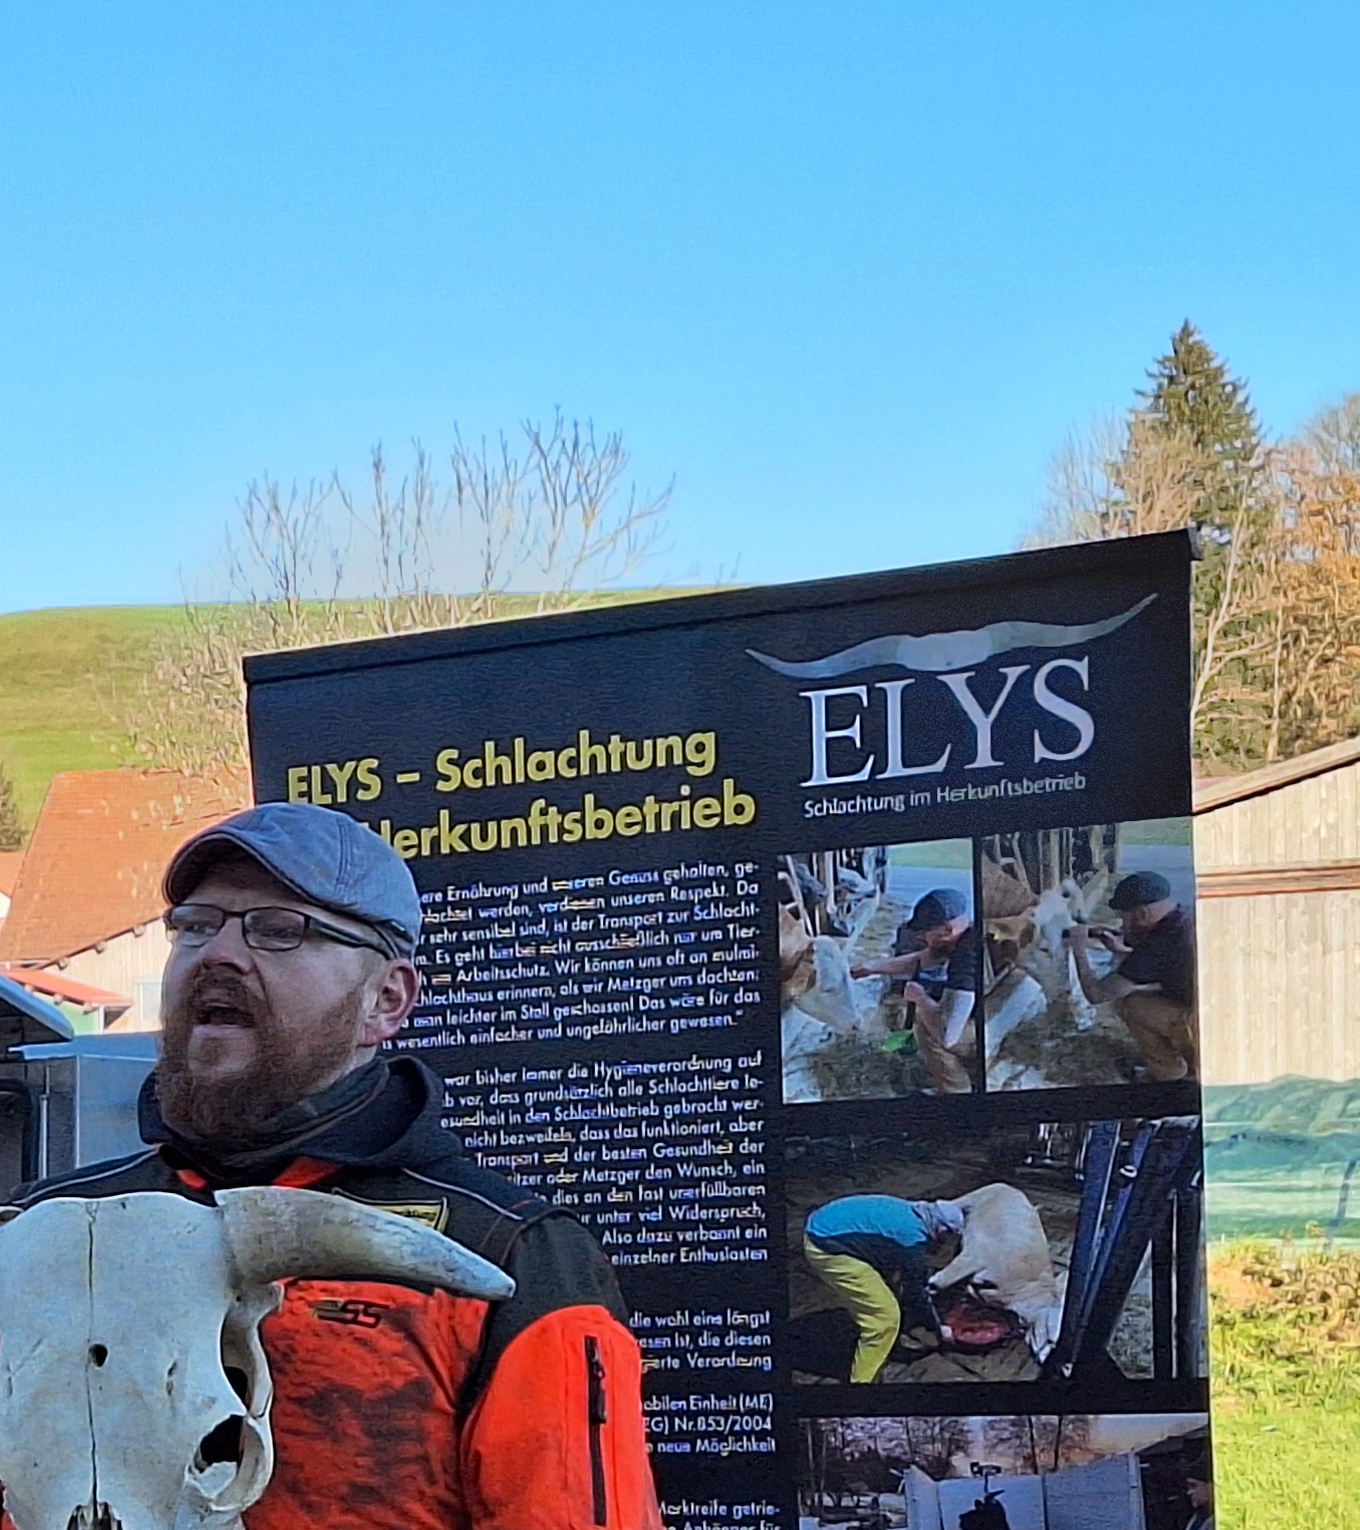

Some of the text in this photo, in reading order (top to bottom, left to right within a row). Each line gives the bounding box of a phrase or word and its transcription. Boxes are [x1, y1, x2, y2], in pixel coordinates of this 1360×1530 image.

[799, 654, 1096, 787] ELYS
[288, 757, 382, 804] ELYS
[435, 729, 717, 793] Schlachtung
[803, 771, 1087, 819] Schlachtung im Herkunftsbetrieb
